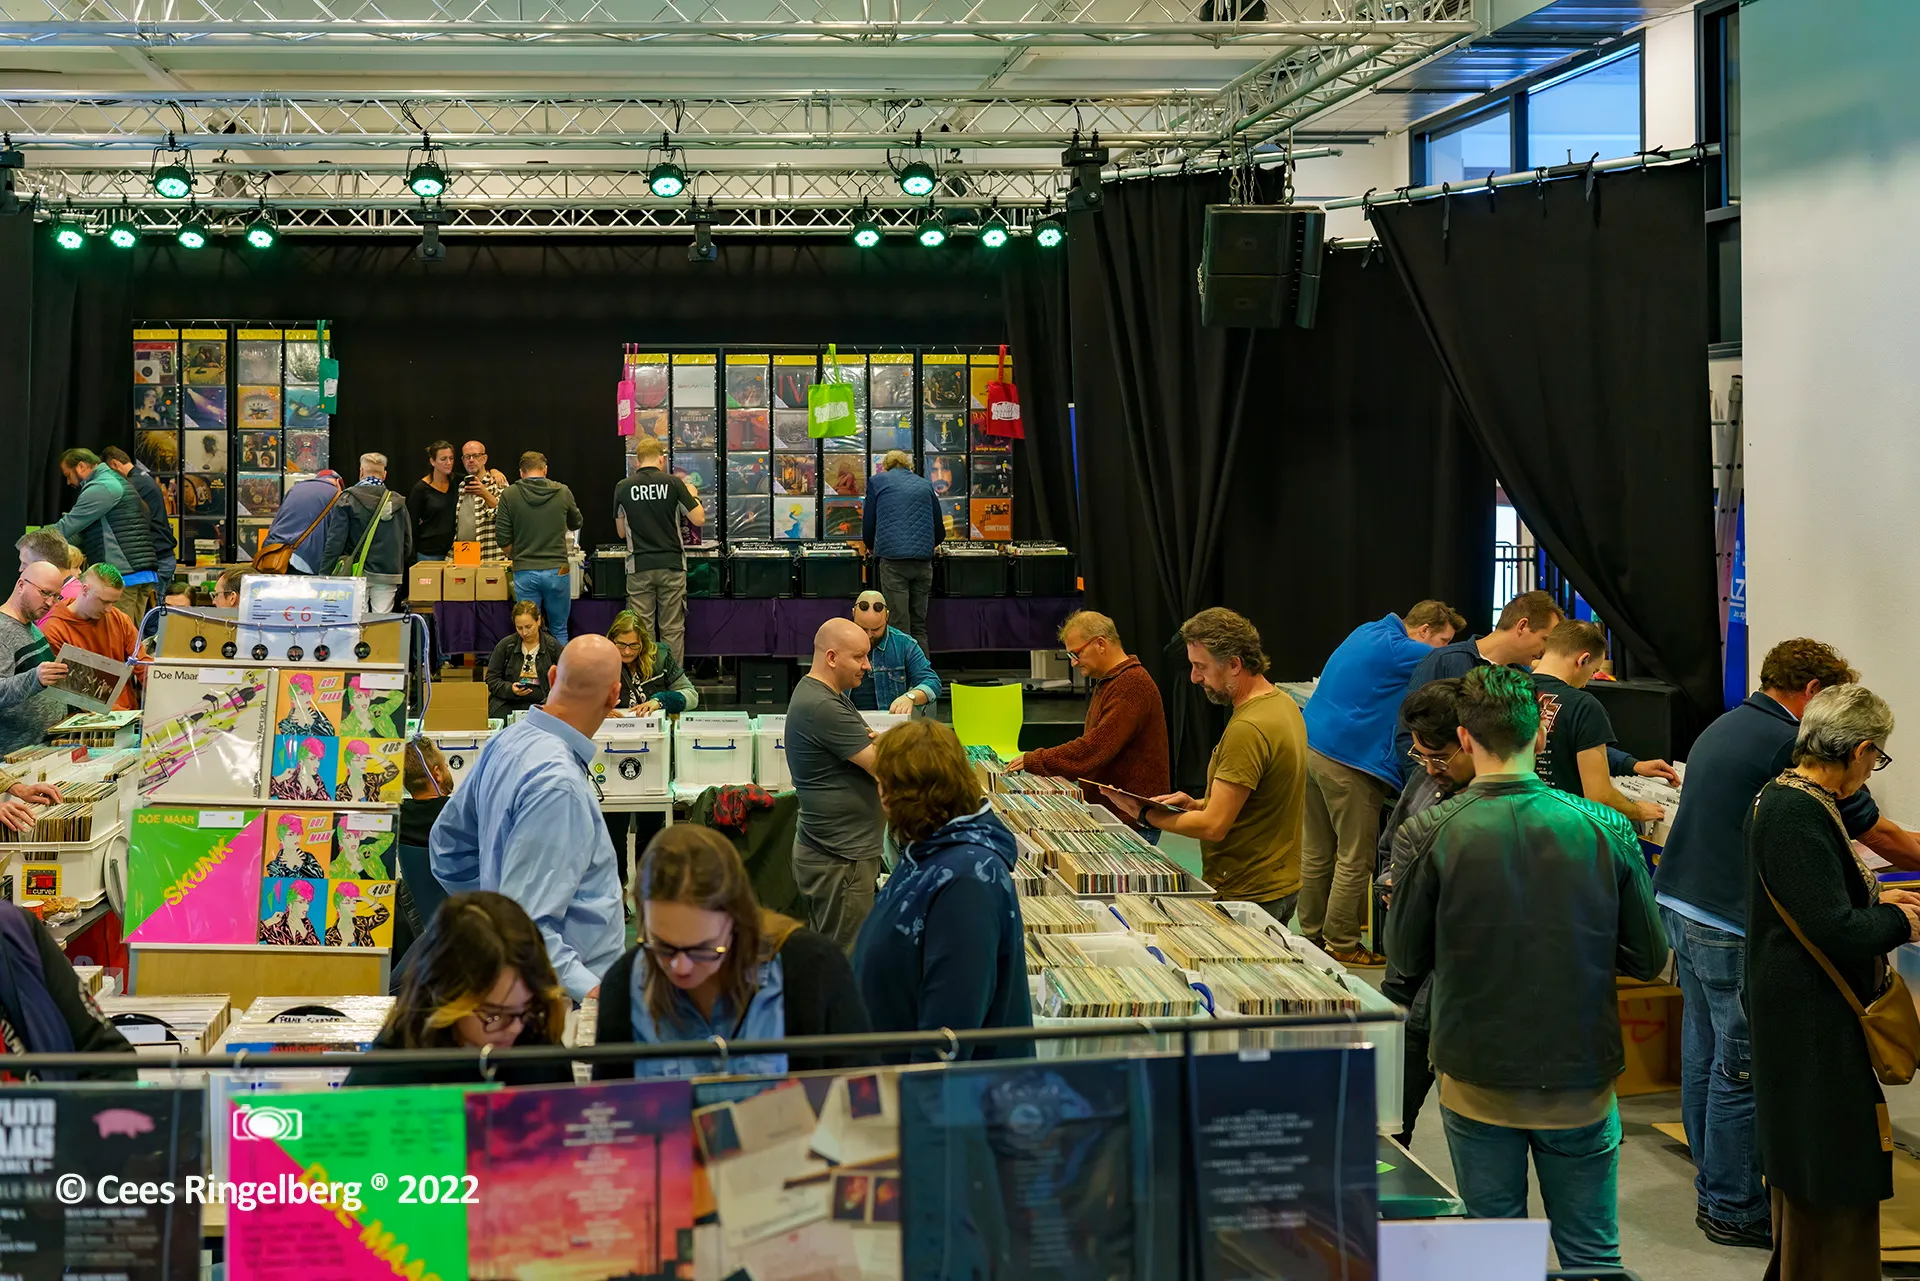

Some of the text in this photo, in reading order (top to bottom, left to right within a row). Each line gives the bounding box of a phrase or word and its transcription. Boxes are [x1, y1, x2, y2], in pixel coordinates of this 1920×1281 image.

[630, 483, 669, 501] CREW
[283, 605, 296, 621] €
[300, 606, 312, 622] 6
[153, 669, 199, 681] Doe Maar
[320, 678, 336, 687] DOE
[320, 691, 343, 701] MAAR
[137, 814, 195, 824] DOE MAAR
[309, 818, 326, 828] DOE
[309, 831, 332, 843] MAAR
[163, 836, 234, 906] SKUNK
[0, 1098, 57, 1126] LOYD
